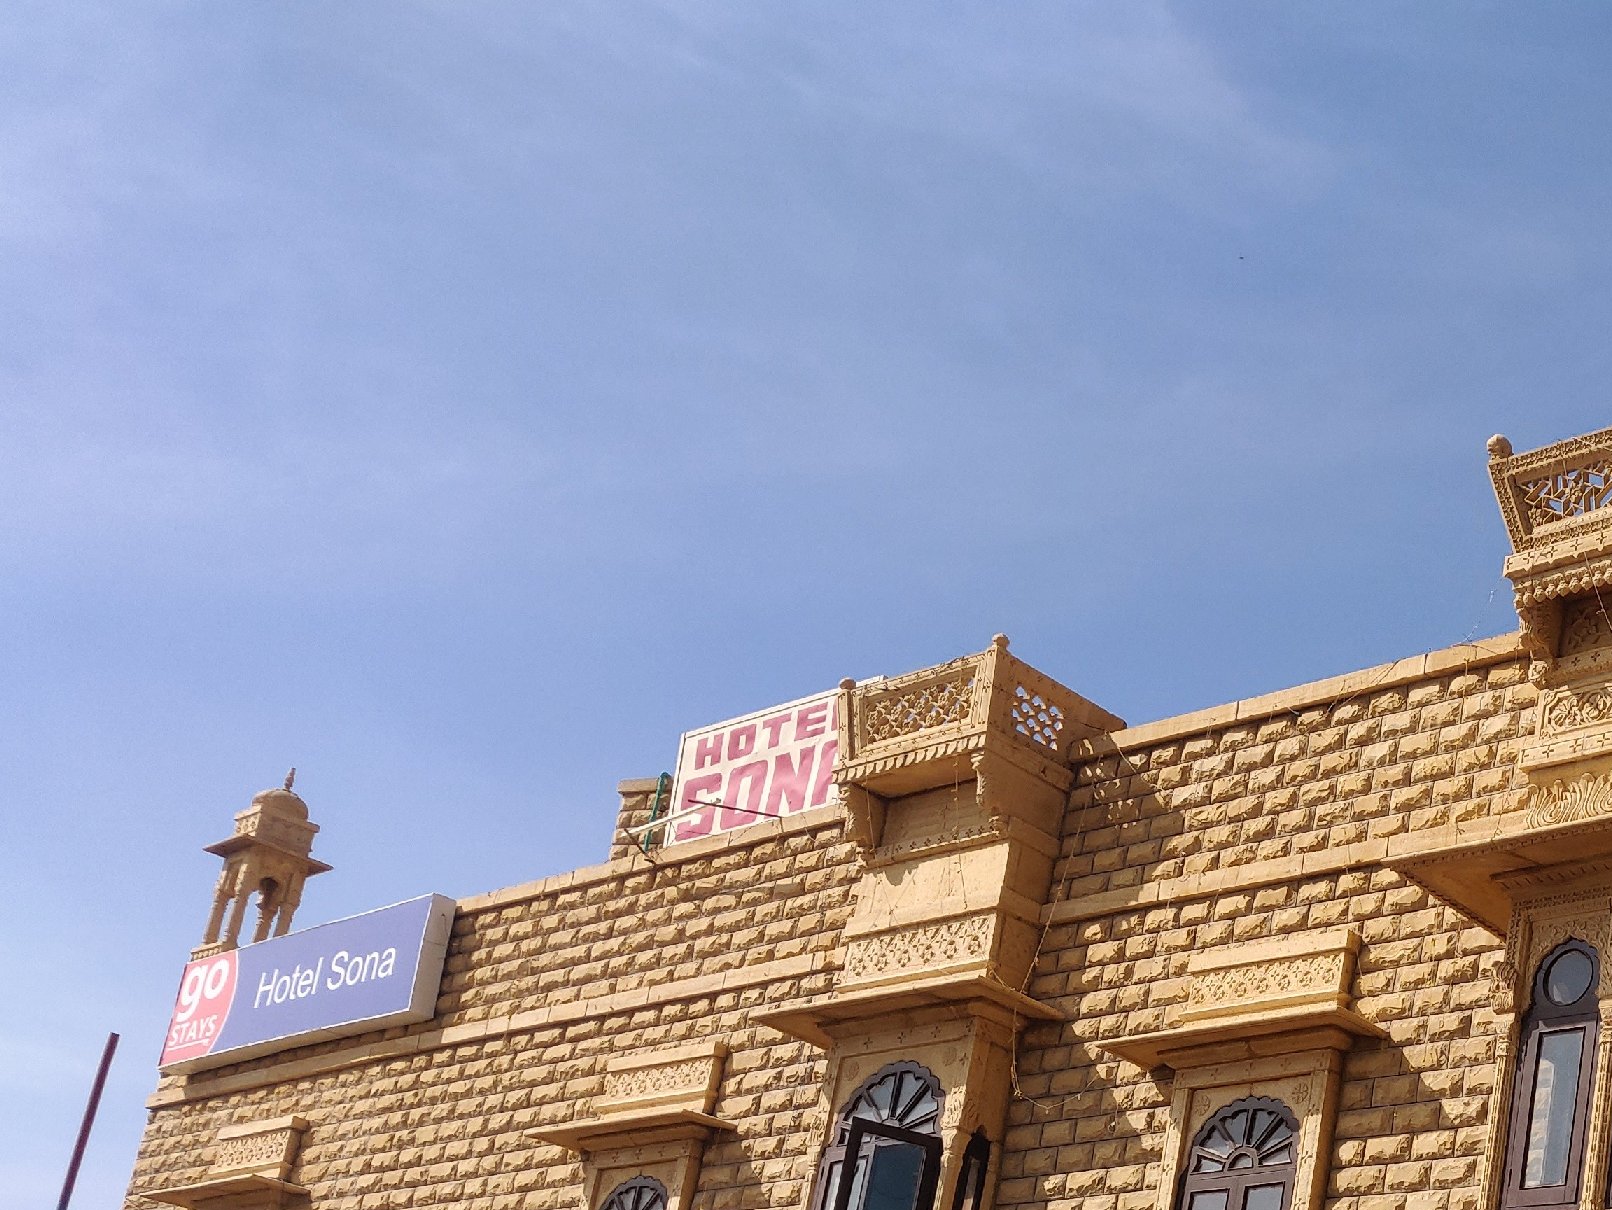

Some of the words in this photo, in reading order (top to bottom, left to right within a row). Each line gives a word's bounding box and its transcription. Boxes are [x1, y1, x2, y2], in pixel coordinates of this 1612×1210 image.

[176, 958, 229, 1021] go
[254, 957, 323, 1009] Hotel
[327, 947, 396, 990] Sona
[170, 1014, 218, 1046] STAYS
